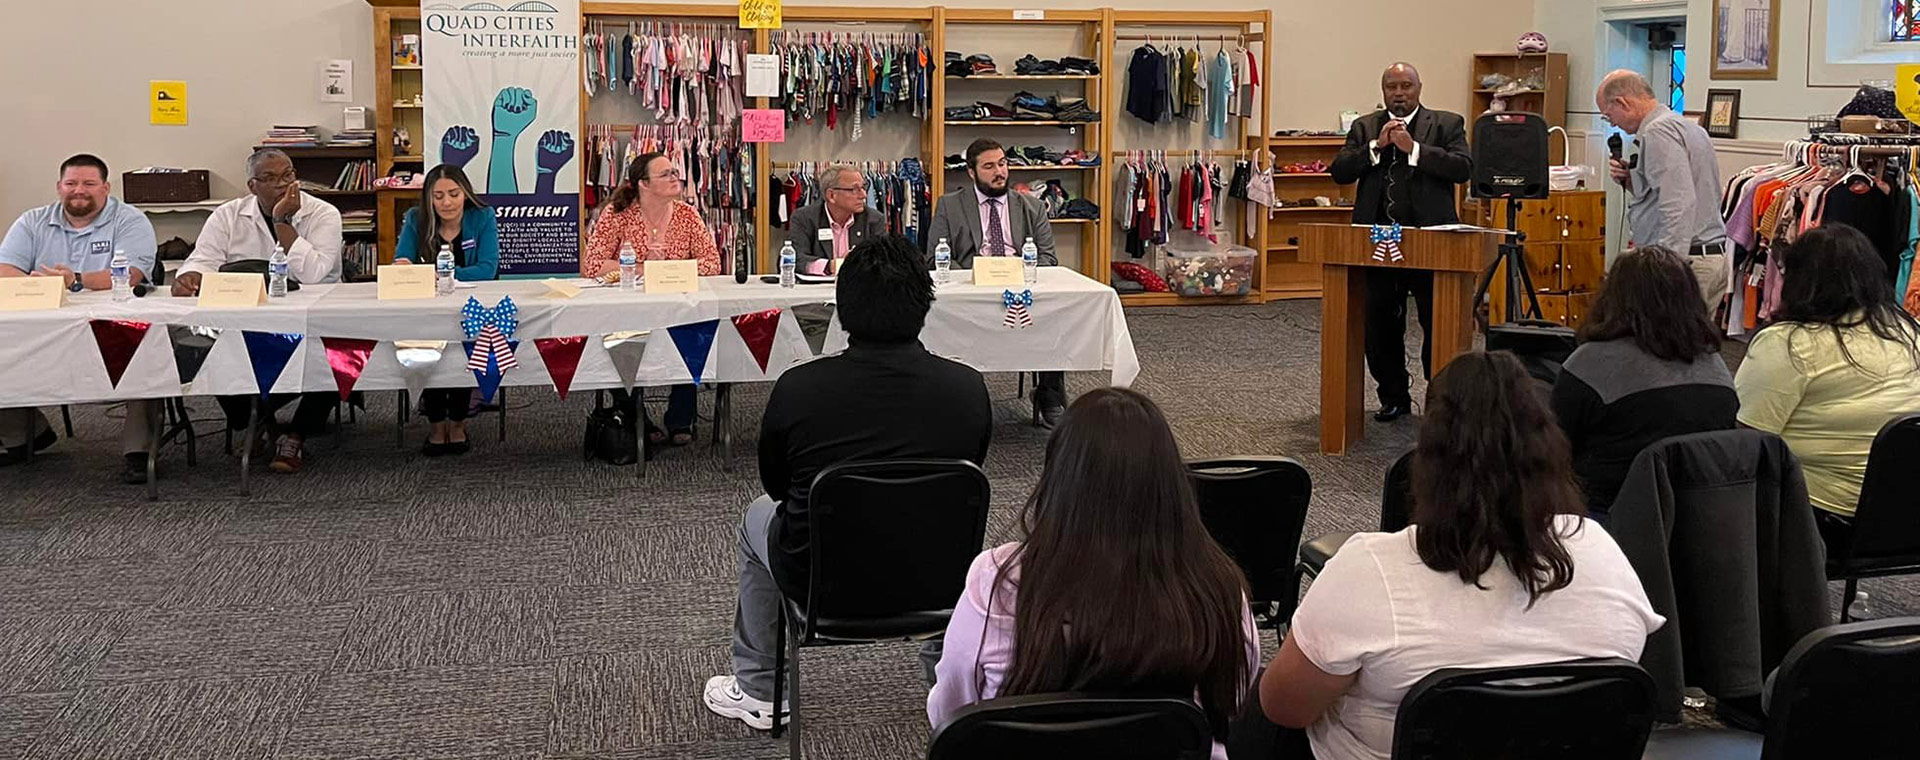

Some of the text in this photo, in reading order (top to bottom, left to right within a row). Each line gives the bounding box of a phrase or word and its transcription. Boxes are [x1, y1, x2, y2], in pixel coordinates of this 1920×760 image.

[426, 13, 554, 36] QUAD CITIES
[463, 33, 577, 49] INTERFAITH
[462, 50, 498, 58] creating
[530, 50, 548, 59] just
[550, 50, 577, 60] society
[495, 206, 569, 218] STATEMENT
